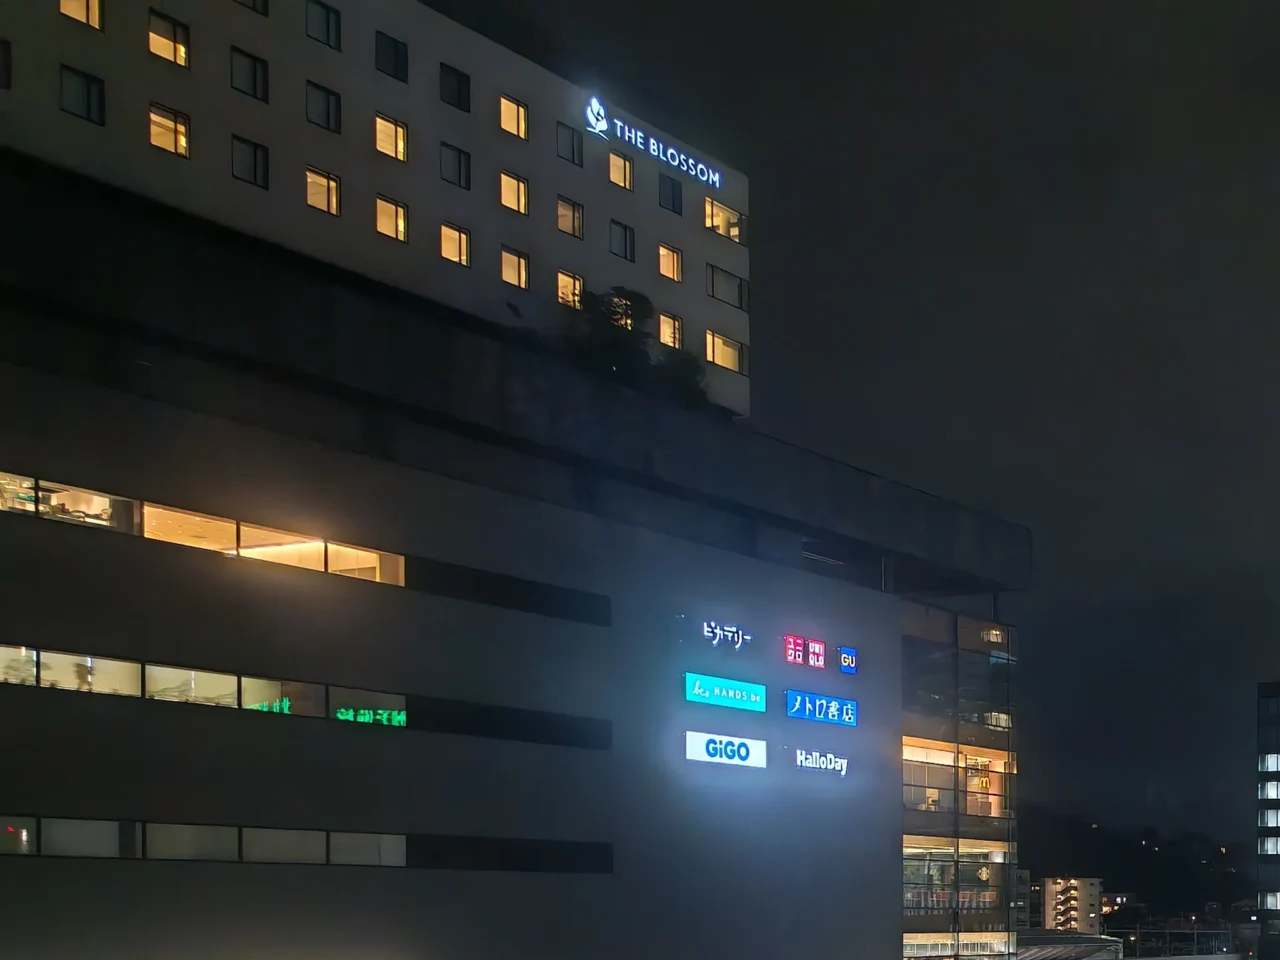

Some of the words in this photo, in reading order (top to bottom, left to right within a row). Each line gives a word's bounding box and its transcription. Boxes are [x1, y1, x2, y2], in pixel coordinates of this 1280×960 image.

[614, 119, 645, 149] THE
[650, 138, 720, 188] BLOSSOM
[703, 621, 752, 649] ピカデリー
[841, 653, 856, 667] GU
[713, 686, 748, 701] HANDS
[750, 692, 761, 703] be
[791, 696, 855, 722] メトロ書店
[705, 738, 750, 762] GiGO
[796, 748, 848, 776] HalloDay
